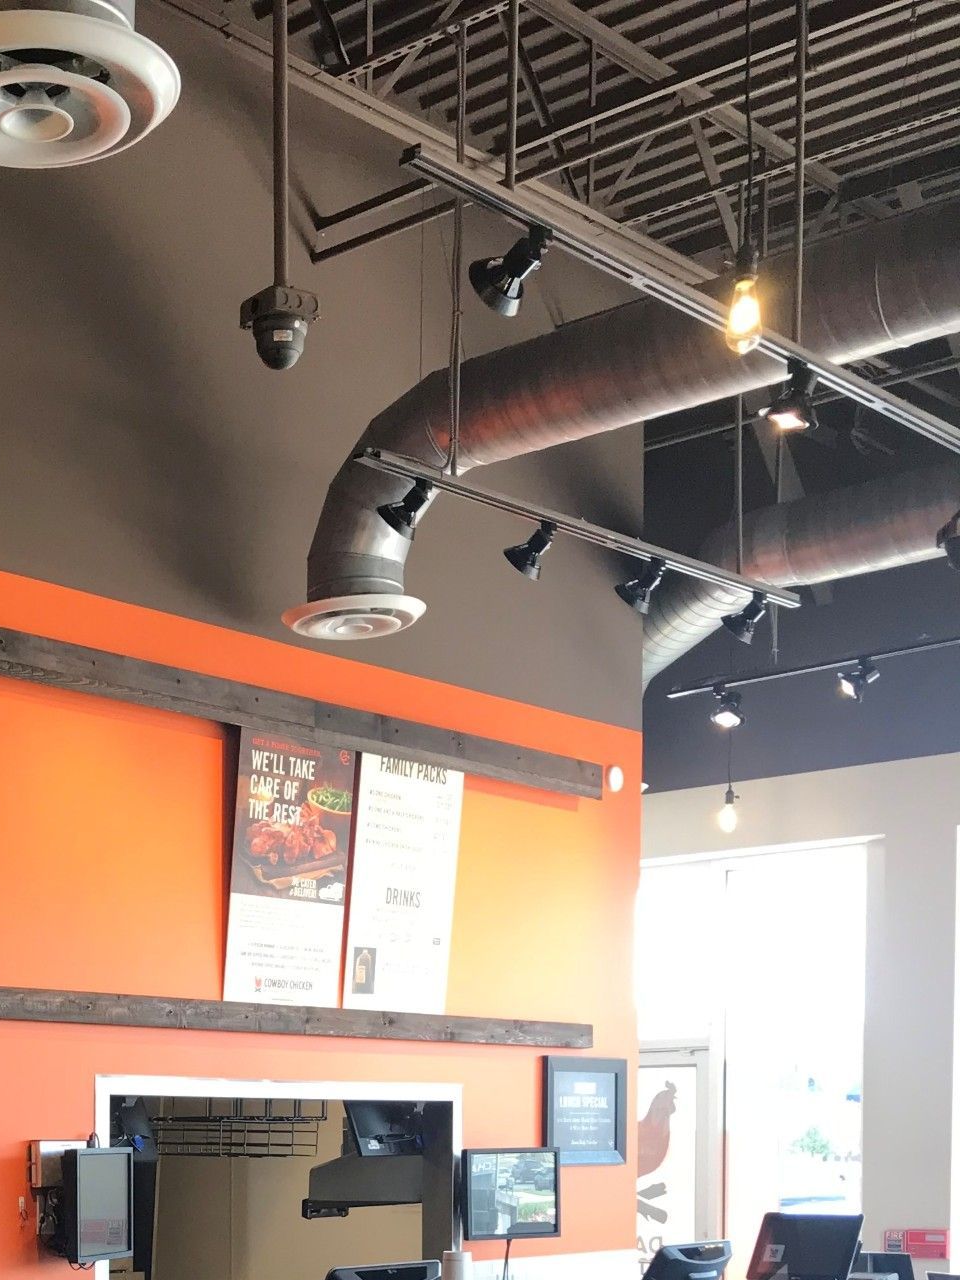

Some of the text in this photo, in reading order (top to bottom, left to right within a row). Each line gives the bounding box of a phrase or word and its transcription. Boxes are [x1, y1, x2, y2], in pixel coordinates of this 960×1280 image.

[251, 749, 316, 780] WE'LL TAKE
[380, 756, 448, 785] FAMILY PACKS
[250, 774, 300, 801] CARE OF
[248, 798, 303, 826] THE REST.
[385, 887, 421, 908] DRINKS
[264, 978, 313, 990] COWBOY CHICKEN
[886, 1231, 903, 1240] FIRE
